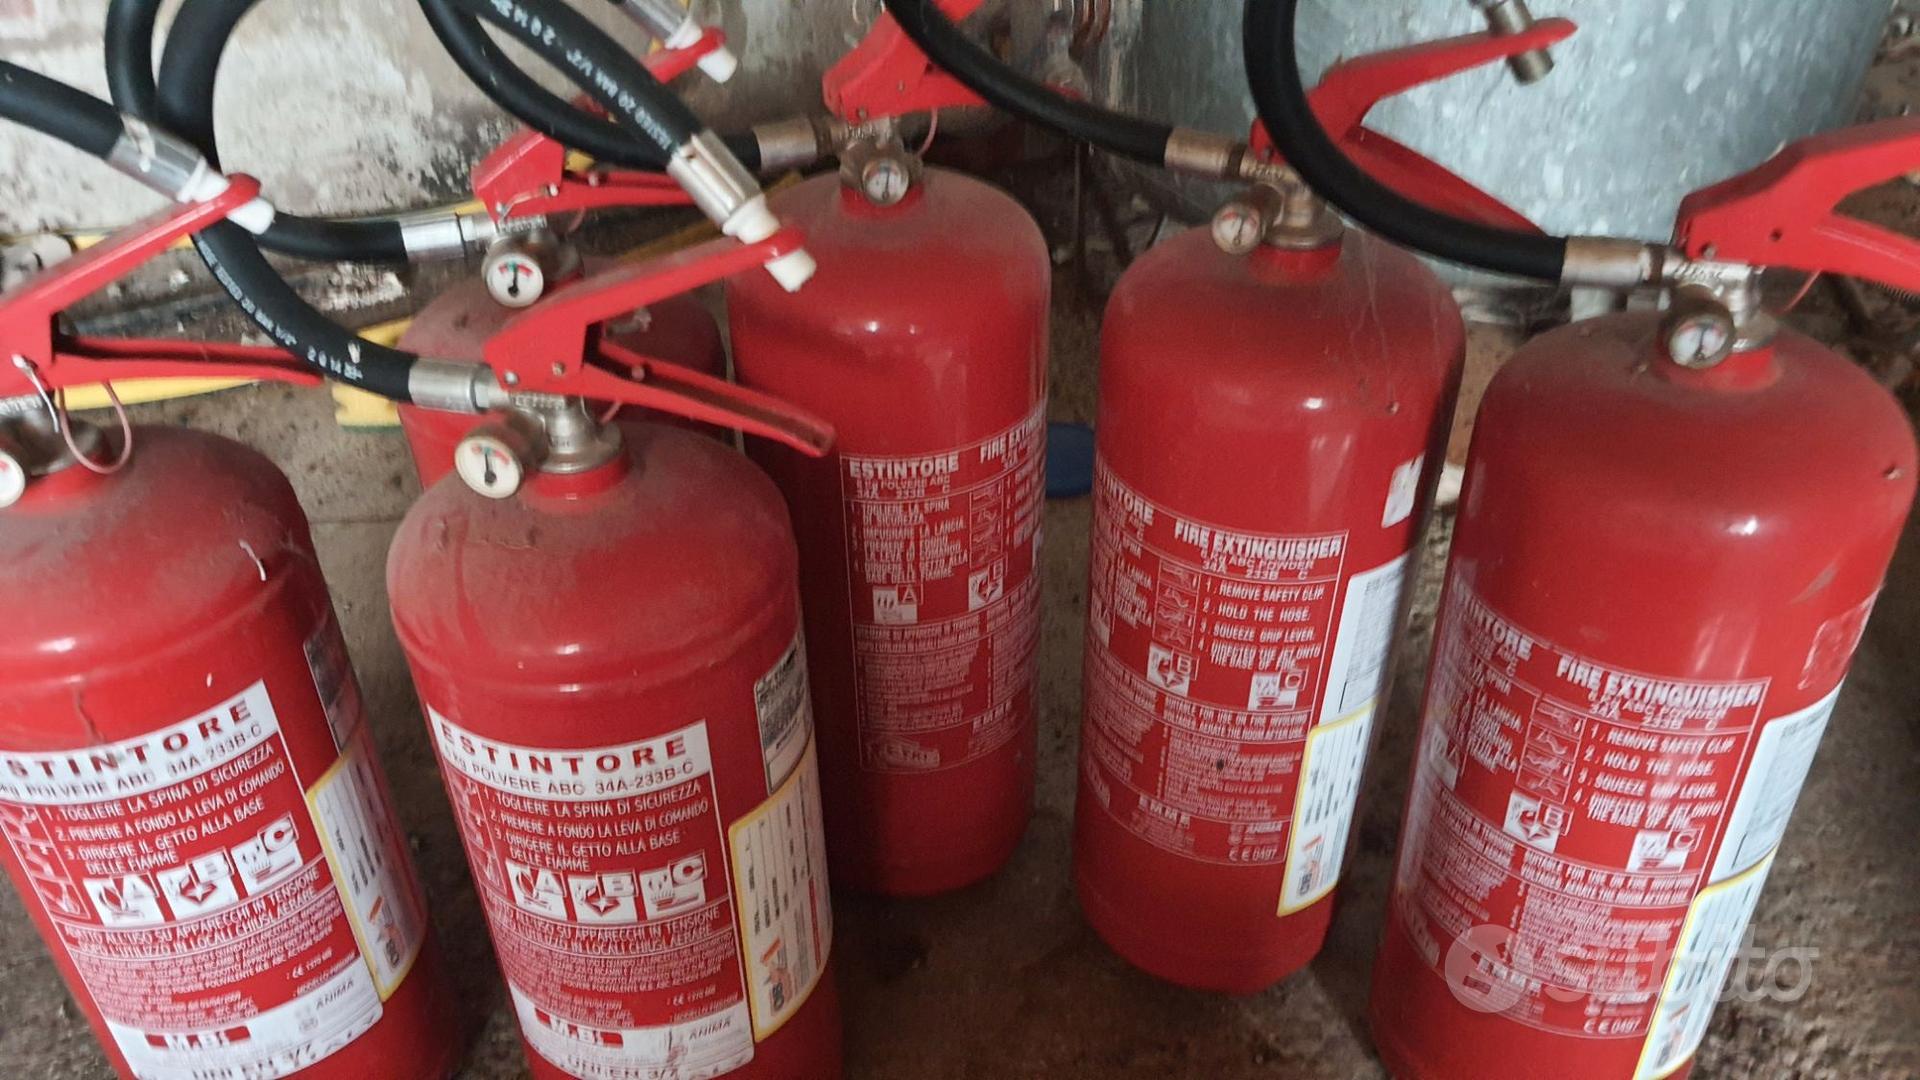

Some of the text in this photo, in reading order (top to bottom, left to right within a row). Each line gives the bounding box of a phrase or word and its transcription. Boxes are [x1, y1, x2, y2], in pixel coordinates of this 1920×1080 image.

[850, 452, 959, 479] ESTINTORE
[1174, 518, 1343, 561] FIRE EXTINGUISHER
[902, 586, 916, 603] A
[1218, 602, 1249, 620] HOLD
[1253, 607, 1275, 623] THE
[1177, 655, 1192, 674] B
[1556, 654, 1764, 709] FIRE EXTINGUISHER
[6, 699, 252, 779] STINTORE
[441, 723, 687, 775] ESTINTORE
[59, 801, 124, 822] TOGLIERE
[127, 798, 146, 814] LA
[149, 786, 191, 810] SPINA
[195, 779, 210, 795] DI
[211, 740, 275, 789] SICUREZZA
[472, 764, 543, 795] POLVERE
[548, 782, 586, 796] ABC
[69, 822, 123, 842] PREMERE
[124, 822, 134, 836] A
[135, 810, 176, 834] FONDO
[177, 805, 194, 821] LA
[196, 794, 224, 816] LEVA
[227, 786, 239, 801] DI
[238, 759, 286, 796] COMANDO
[496, 792, 549, 816] TOGLIERE
[553, 803, 571, 818] LA
[573, 801, 614, 819] SPINA
[617, 800, 631, 815] DI
[635, 781, 701, 812] SICUREZZA
[500, 814, 545, 835] PREMERE
[547, 824, 556, 837] A
[557, 823, 595, 839] FONDO
[598, 823, 613, 838] LA
[614, 820, 642, 837] LEVA
[645, 817, 656, 832] DI
[658, 799, 709, 828] COMANDO
[79, 842, 136, 862] DIRIGERE
[137, 841, 151, 855] IL
[154, 830, 199, 852] GETTO
[201, 816, 233, 838] ALLA
[234, 797, 265, 822] BASE
[506, 832, 554, 856] DIRIGERE
[557, 842, 569, 857] IL
[572, 841, 612, 859] GETTO
[615, 839, 647, 857] ALLA
[650, 831, 680, 850] BASE
[87, 850, 180, 876] DELLE FIAMME
[509, 847, 591, 873] DELLE FIAMME
[155, 928, 174, 944] SU
[175, 906, 254, 938] APPARECCHI
[268, 867, 321, 905] TENSIONE
[173, 939, 187, 953] IN
